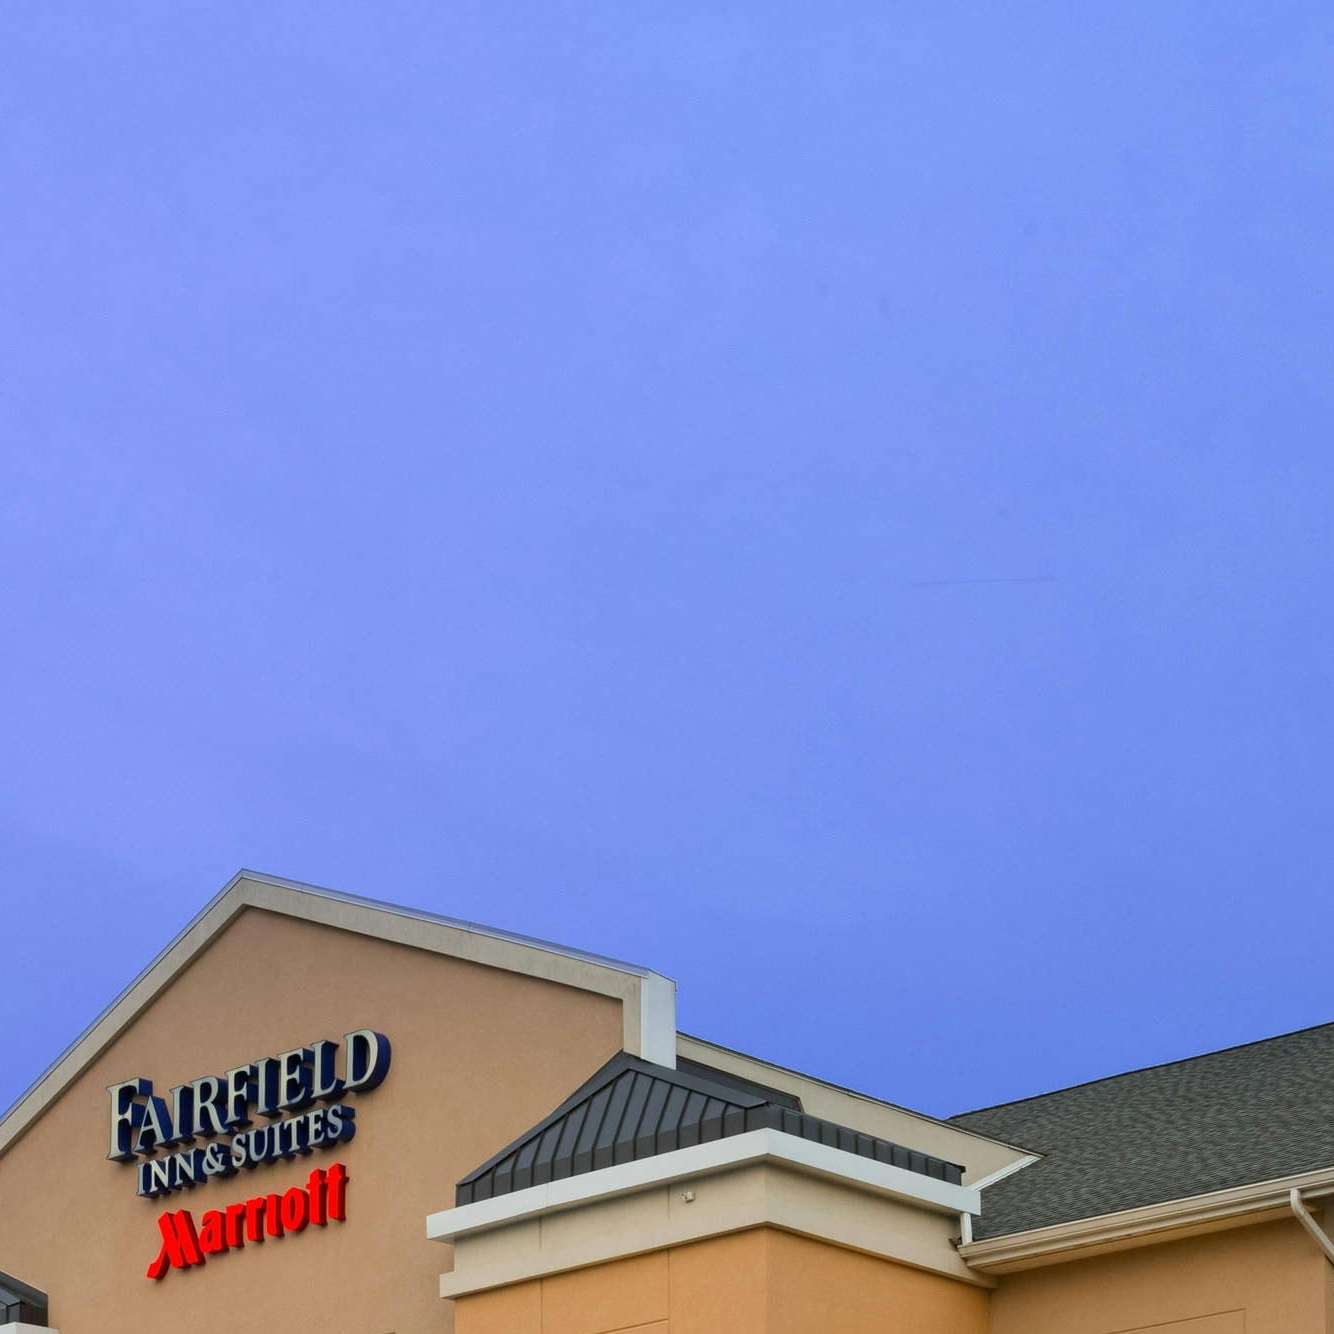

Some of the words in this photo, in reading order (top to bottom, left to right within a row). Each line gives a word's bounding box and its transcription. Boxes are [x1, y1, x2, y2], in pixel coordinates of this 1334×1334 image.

[106, 1028, 391, 1162] FAIRFIELD
[136, 1148, 207, 1198] INN
[201, 1141, 237, 1177] &
[231, 1104, 356, 1170] SUITES
[146, 1162, 349, 1280] Marriott
